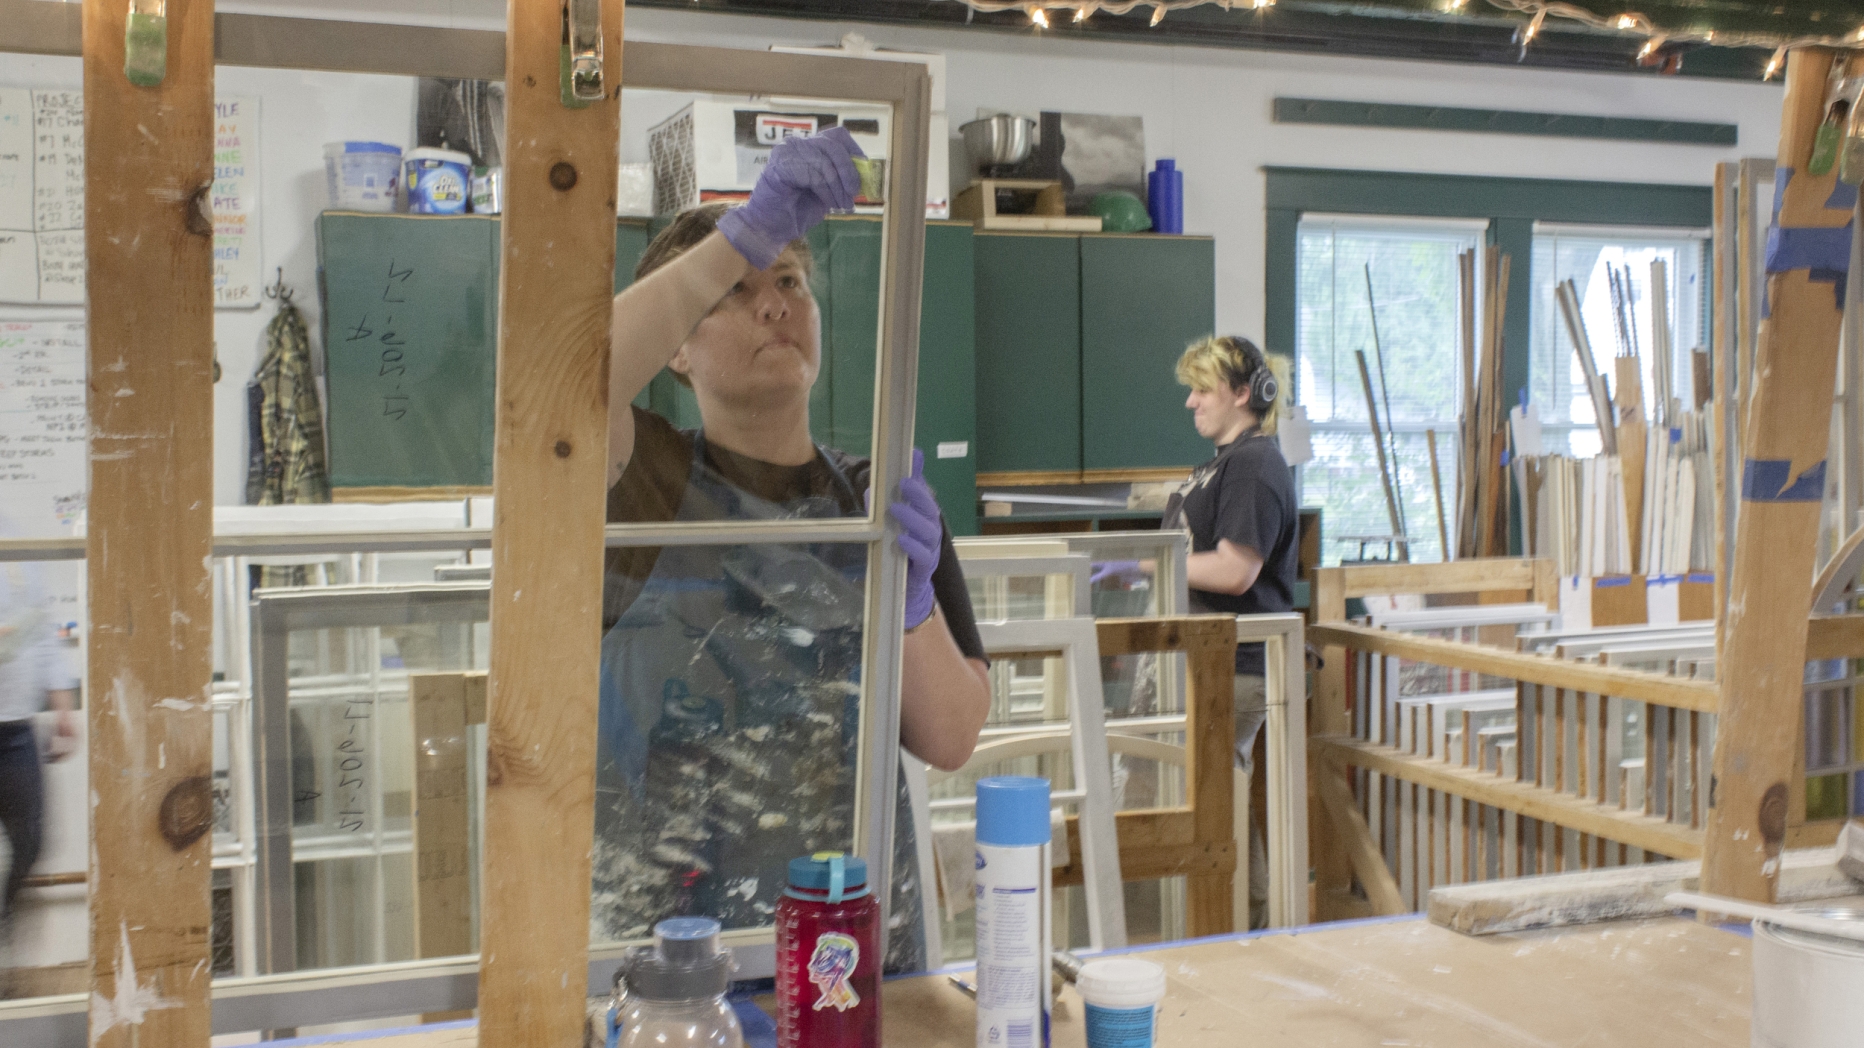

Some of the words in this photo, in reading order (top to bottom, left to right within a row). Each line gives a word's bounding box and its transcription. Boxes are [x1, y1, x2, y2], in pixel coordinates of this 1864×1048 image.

[215, 102, 239, 118] YLE
[764, 126, 812, 141] JET
[214, 196, 241, 210] ATE
